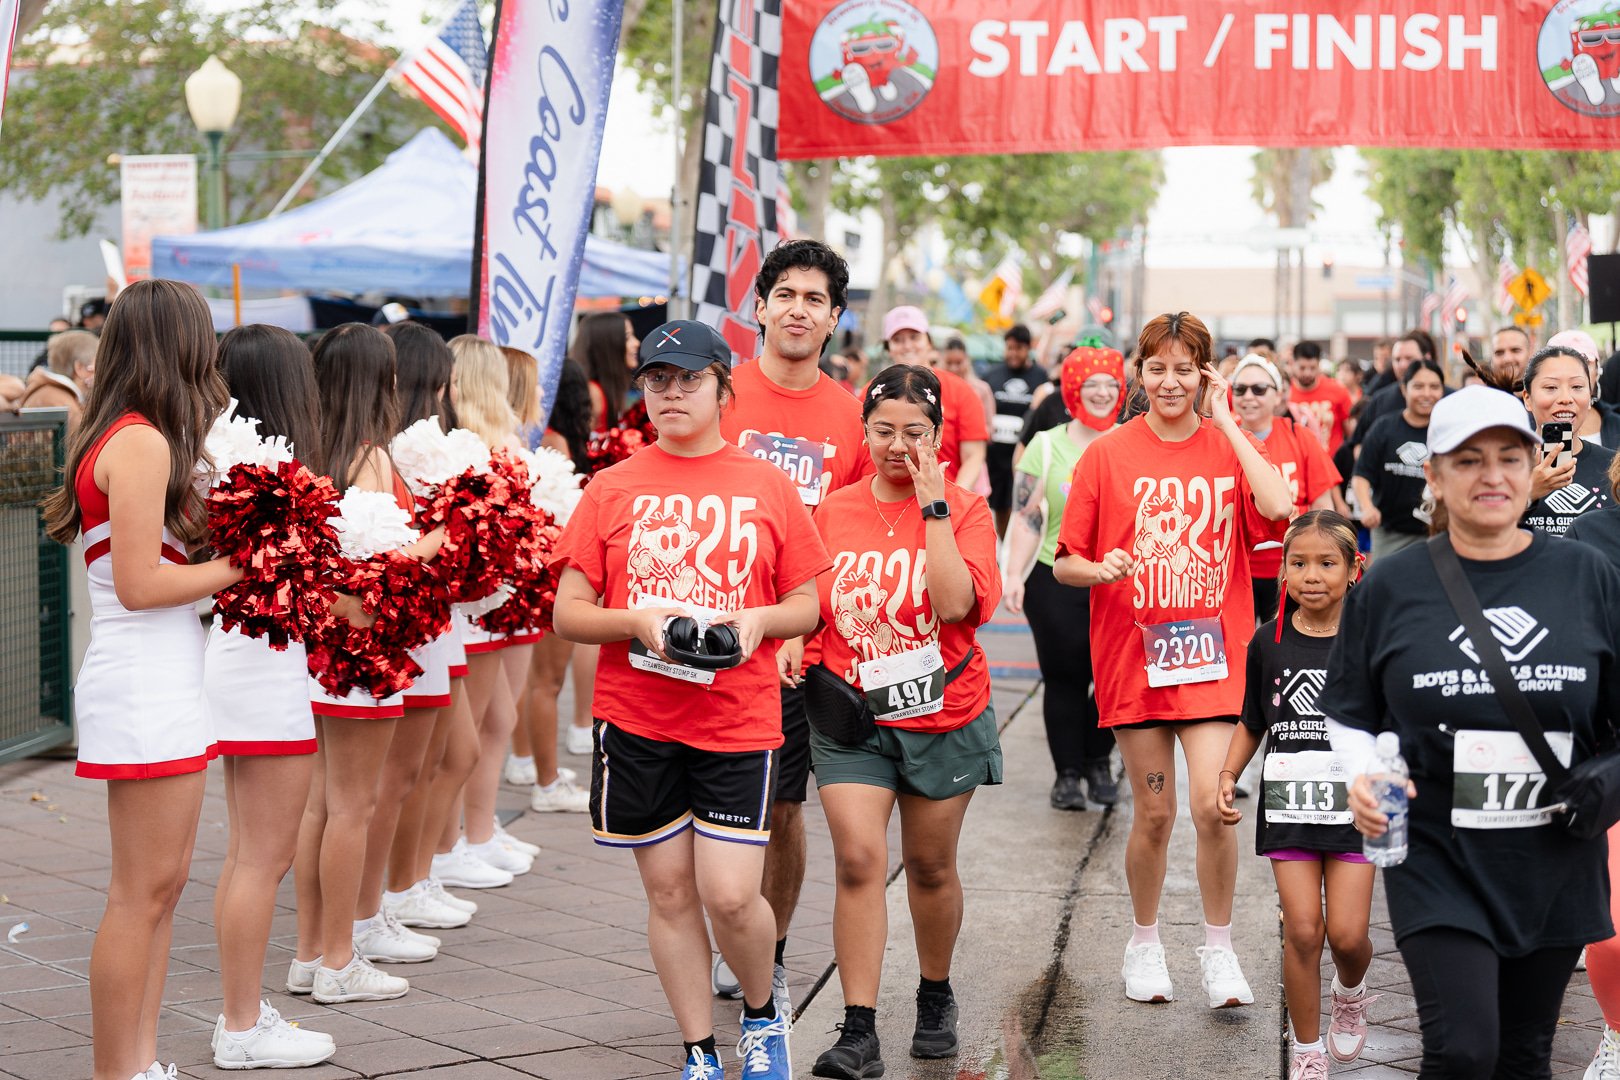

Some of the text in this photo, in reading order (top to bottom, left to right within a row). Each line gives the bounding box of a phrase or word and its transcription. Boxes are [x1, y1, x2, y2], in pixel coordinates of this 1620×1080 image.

[968, 13, 1498, 77] START / FINISH
[513, 45, 585, 260] Coast
[1133, 476, 1235, 563] 2025
[1546, 517, 1555, 526] &
[628, 493, 758, 588] 2025
[831, 548, 938, 636] 2025
[1133, 556, 1203, 609] STOMP
[1154, 632, 1215, 668] 2320
[642, 660, 672, 672] STRAWBERRY
[672, 667, 690, 677] STOMP
[1413, 670, 1459, 689] BOYS
[1461, 669, 1478, 683] &
[1535, 664, 1587, 682] CLUBS
[888, 675, 933, 710] 497
[1442, 684, 1460, 697] OF
[1518, 680, 1563, 692] GROVE
[1289, 732, 1321, 740] GARDEN
[1290, 721, 1298, 730] &
[1285, 782, 1334, 811] 113
[1482, 773, 1547, 810] 177
